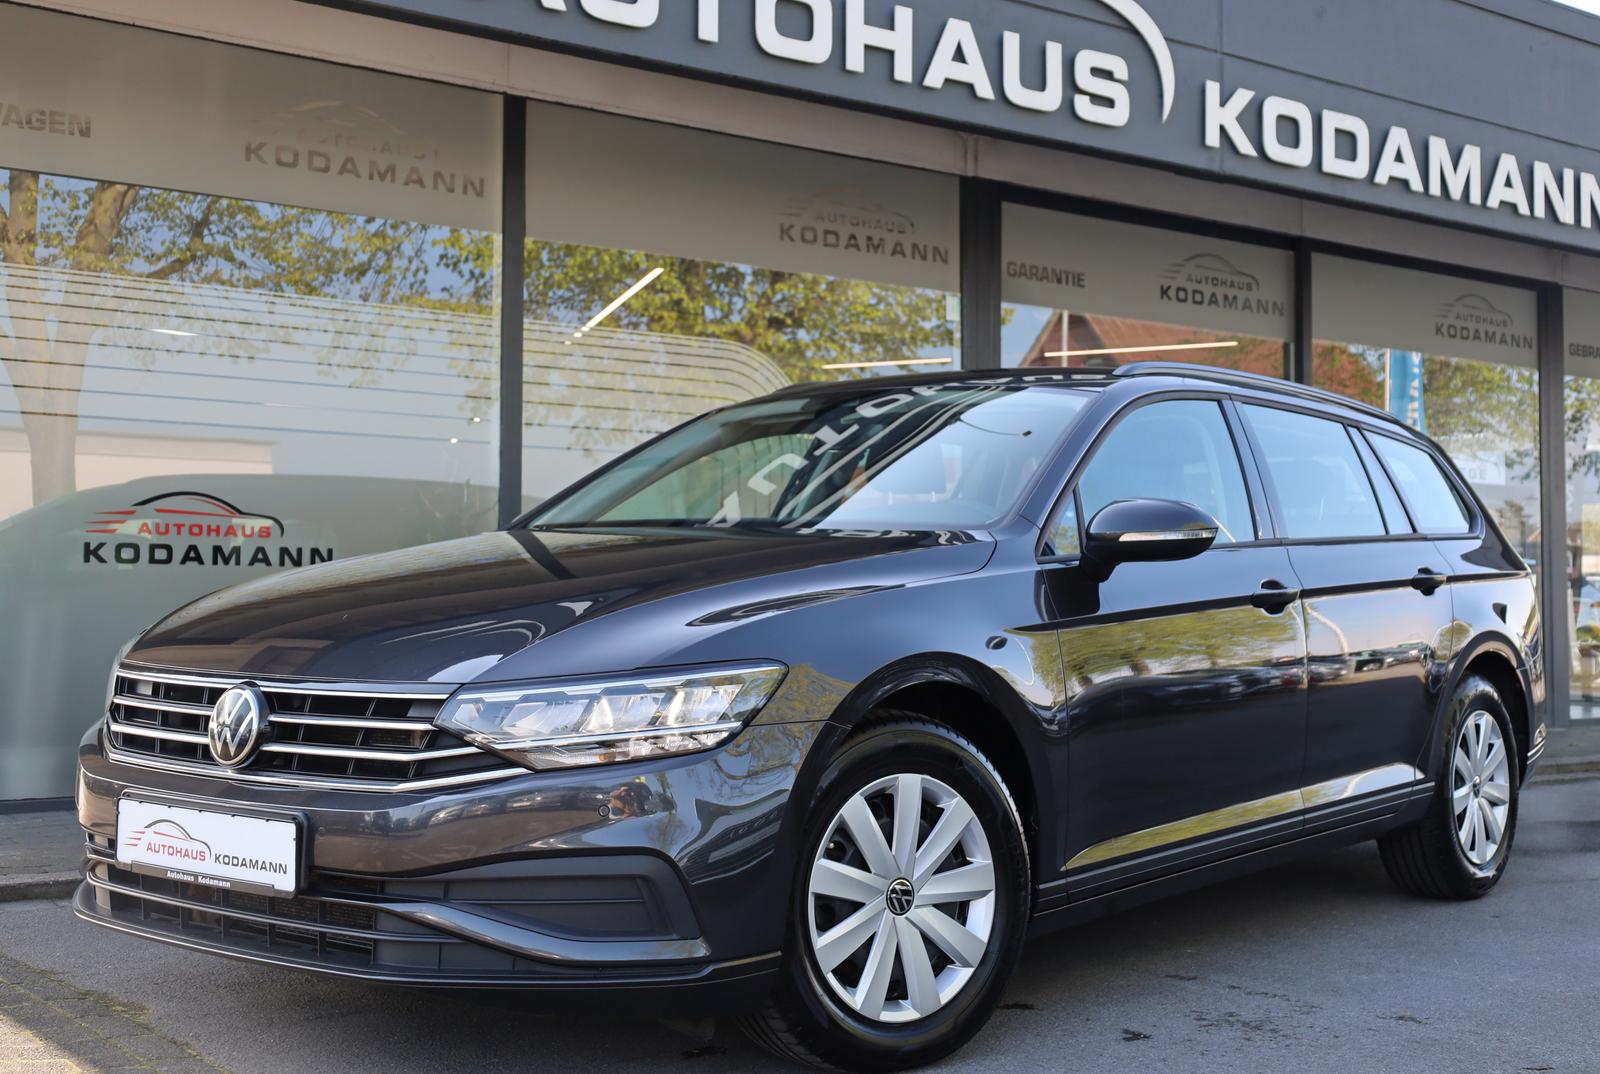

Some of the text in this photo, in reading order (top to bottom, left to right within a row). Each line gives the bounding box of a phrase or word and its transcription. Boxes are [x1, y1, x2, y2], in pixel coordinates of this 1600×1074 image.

[541, 0, 1129, 127] TOHAUS
[0, 102, 91, 138] AGEN
[244, 140, 486, 198] KODAMANN
[779, 222, 950, 265] KODAMANN
[1006, 260, 1086, 289] GARANTIE
[1185, 272, 1254, 292] AUTOHAUS
[1160, 283, 1285, 317] KODAMANN
[1455, 311, 1508, 328] AUTOHAUS
[1434, 321, 1534, 350] KODAMANN
[137, 521, 272, 539] AUTOHAUS
[83, 541, 334, 567] KODAMANN
[146, 841, 288, 875] AUTOHAUS KODAMANN
[166, 870, 231, 888] Autohaus Kodamann
